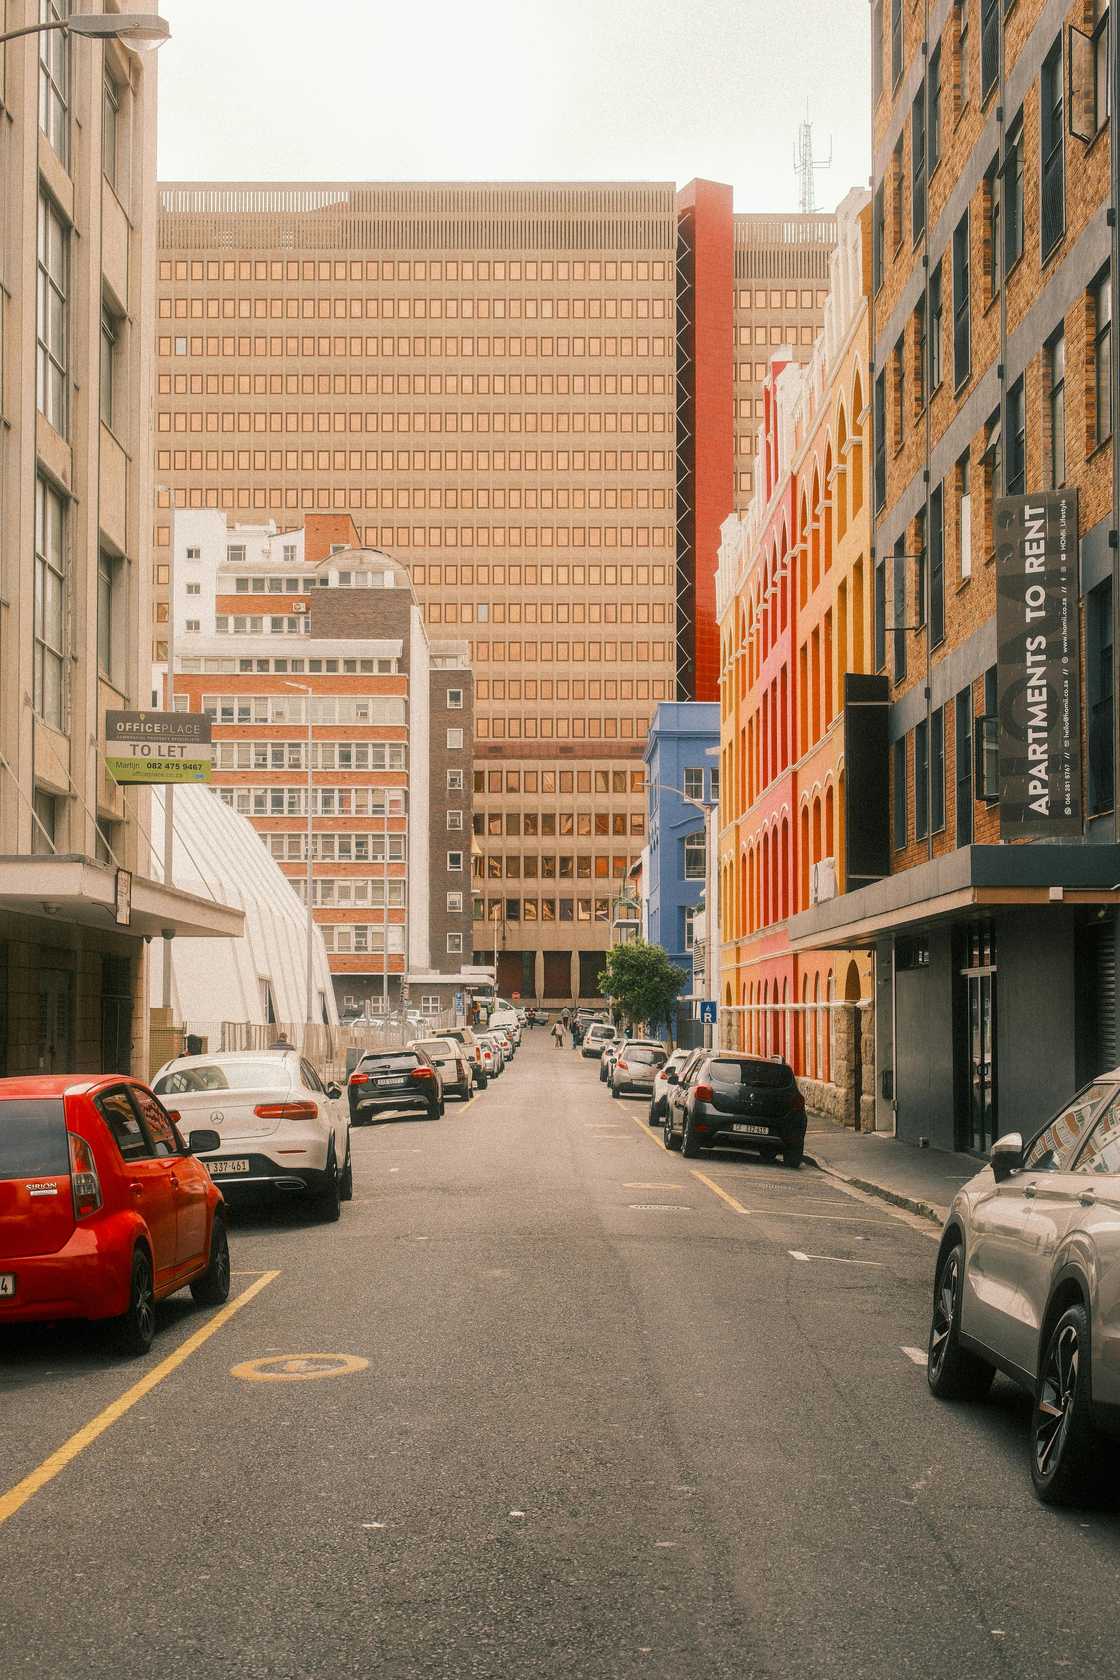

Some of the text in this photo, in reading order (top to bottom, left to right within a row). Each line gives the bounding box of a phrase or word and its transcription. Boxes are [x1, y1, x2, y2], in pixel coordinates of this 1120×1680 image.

[1024, 505, 1049, 816] APARTMENTS TO RENT
[116, 722, 201, 734] OFFICEPLACE
[130, 744, 187, 758] TO LET
[704, 1012, 712, 1023] R
